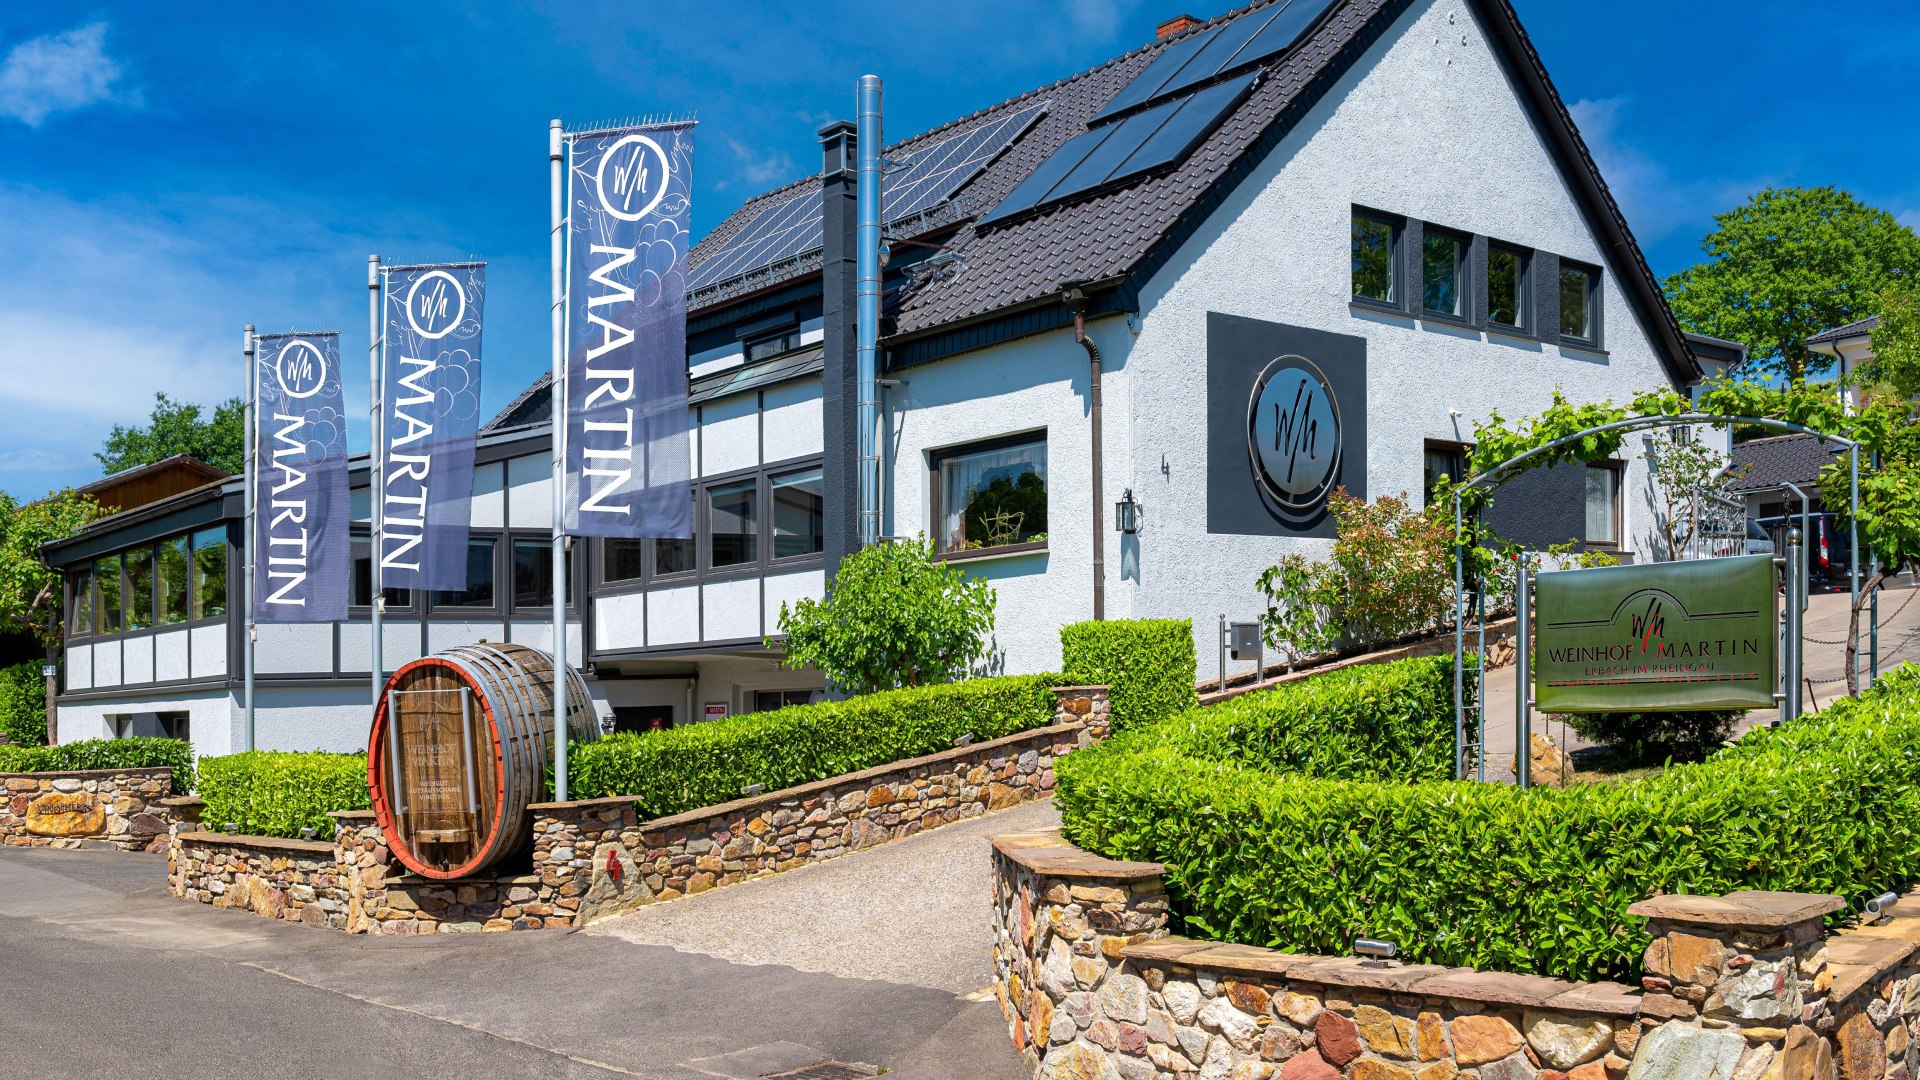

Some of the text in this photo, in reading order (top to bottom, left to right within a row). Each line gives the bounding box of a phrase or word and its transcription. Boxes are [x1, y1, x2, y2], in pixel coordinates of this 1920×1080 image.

[578, 243, 637, 517] MARTIN
[381, 355, 437, 574] MARTIN
[265, 412, 308, 608] MARTIN
[1548, 638, 1758, 664] WEINHOF MARTIN
[1585, 662, 1714, 676] ERBACH IM RHEINGAU
[407, 744, 457, 754] WEINHOF
[605, 849, 622, 881] 4
